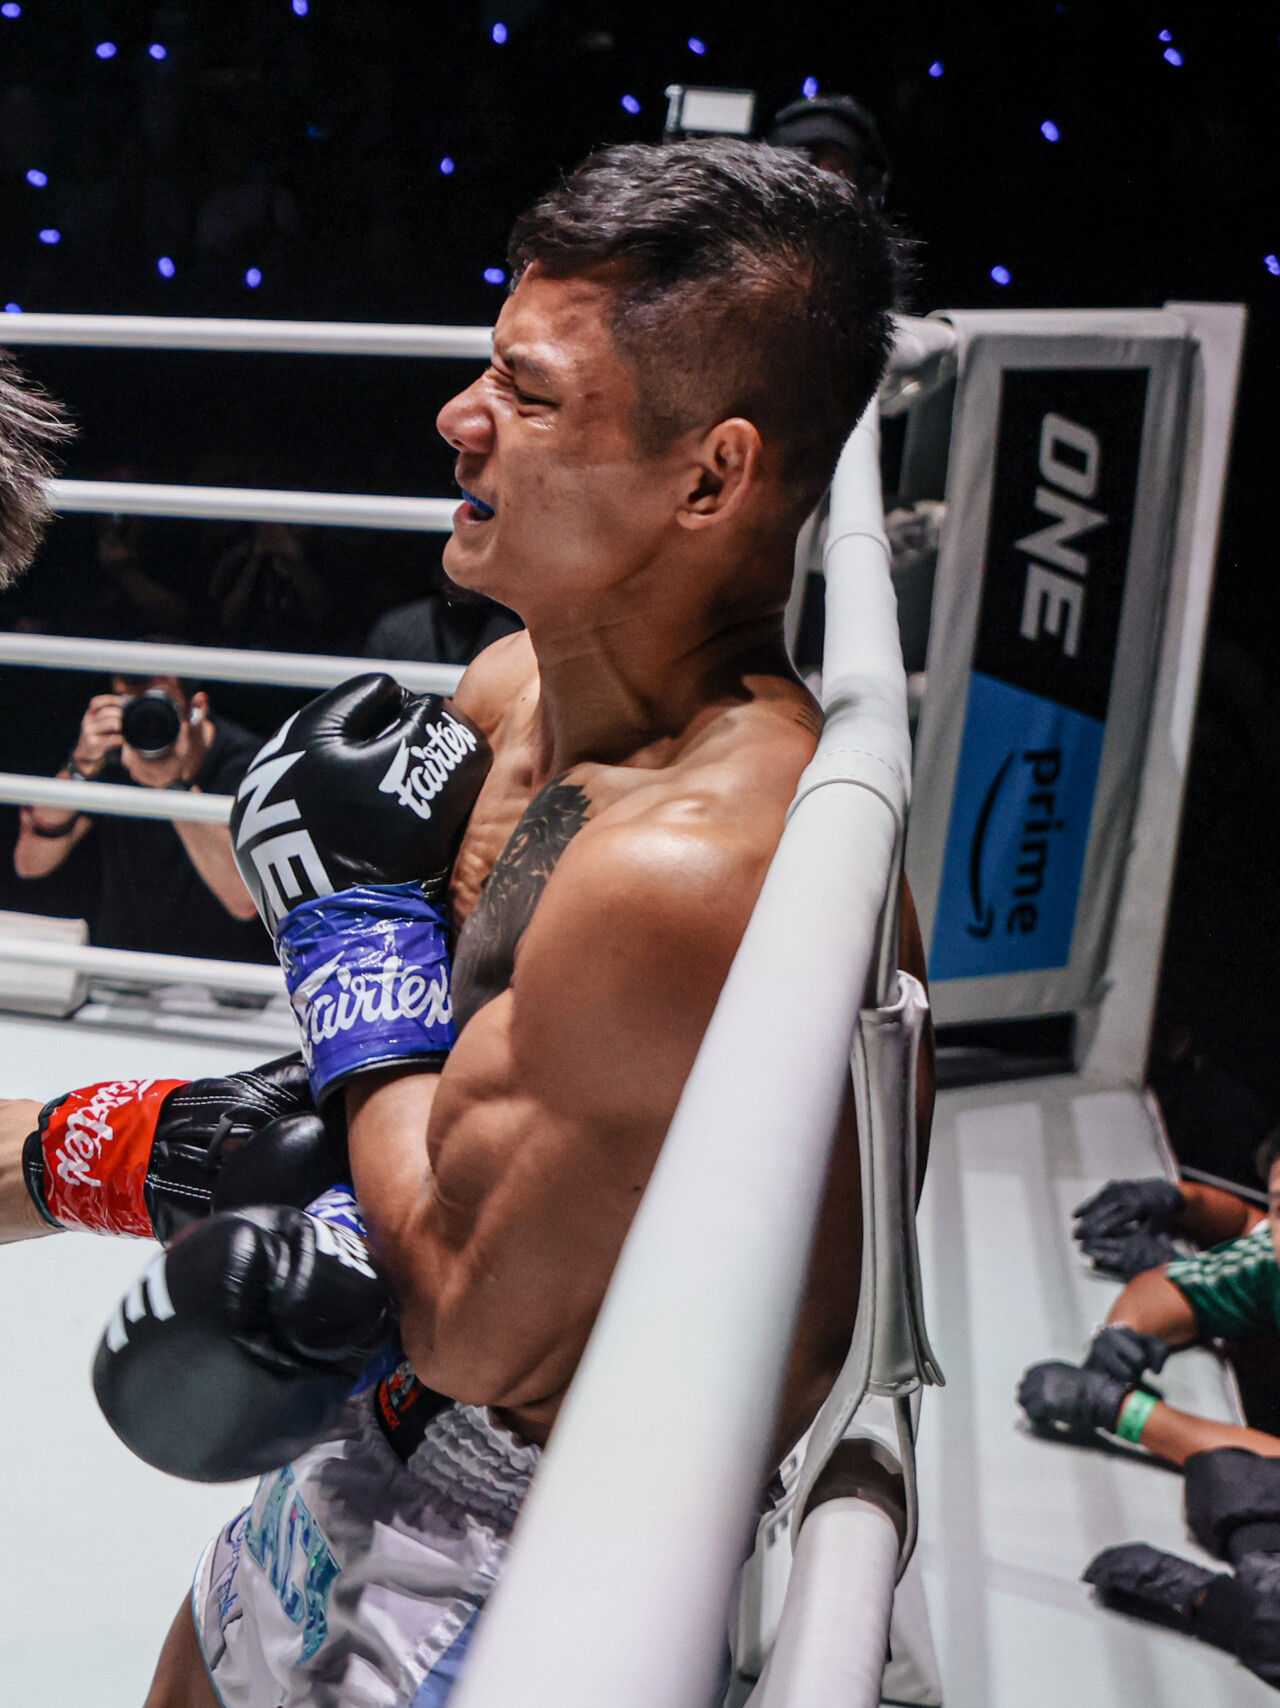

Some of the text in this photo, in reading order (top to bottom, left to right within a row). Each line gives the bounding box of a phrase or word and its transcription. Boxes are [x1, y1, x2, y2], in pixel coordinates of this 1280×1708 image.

[1015, 411, 1109, 658] ONE
[378, 710, 477, 820] Fairtex
[1006, 747, 1063, 936] prime
